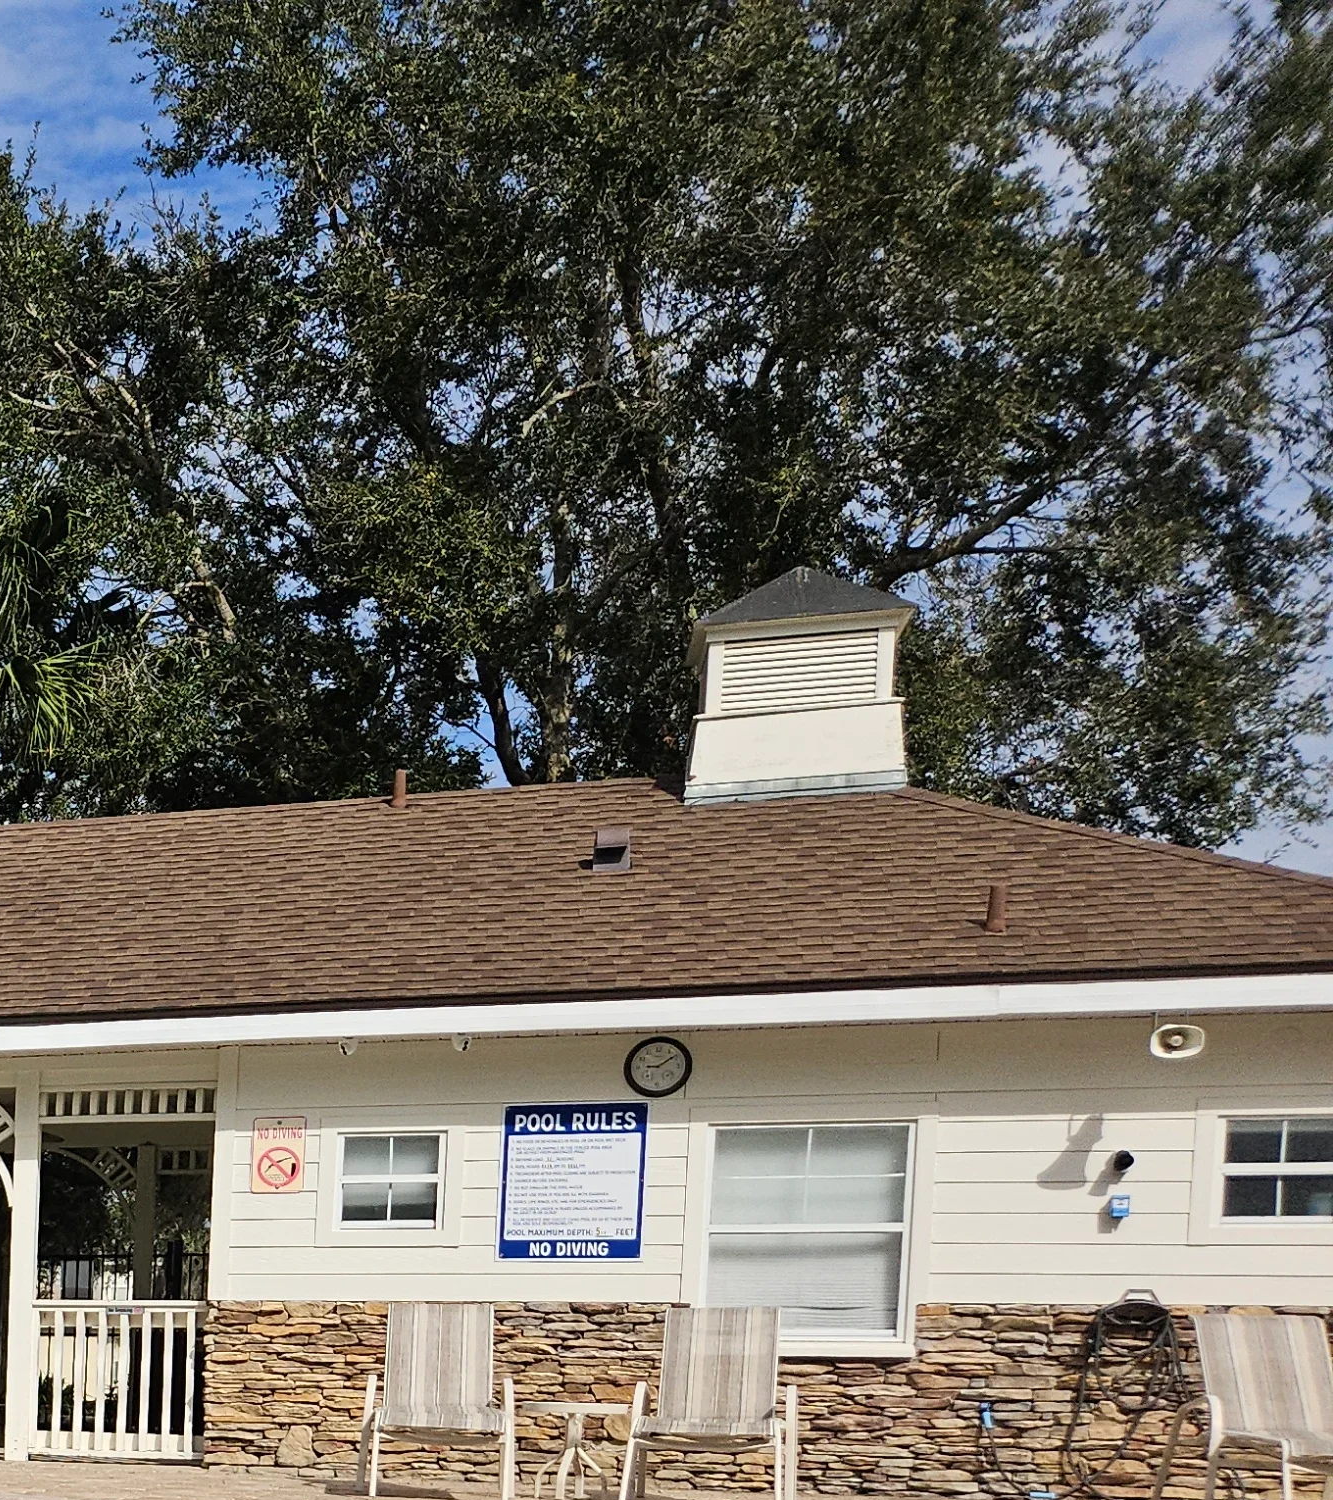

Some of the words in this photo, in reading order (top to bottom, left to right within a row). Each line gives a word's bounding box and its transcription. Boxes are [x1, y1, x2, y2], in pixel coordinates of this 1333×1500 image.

[514, 1113, 566, 1132] POOL
[572, 1112, 637, 1131] RULES
[257, 1128, 269, 1140] NO
[272, 1126, 303, 1139] DIVING
[528, 1228, 565, 1236] MAXIMUM
[615, 1228, 634, 1236] FEET
[529, 1242, 551, 1256] NO
[556, 1241, 609, 1256] DIVING
